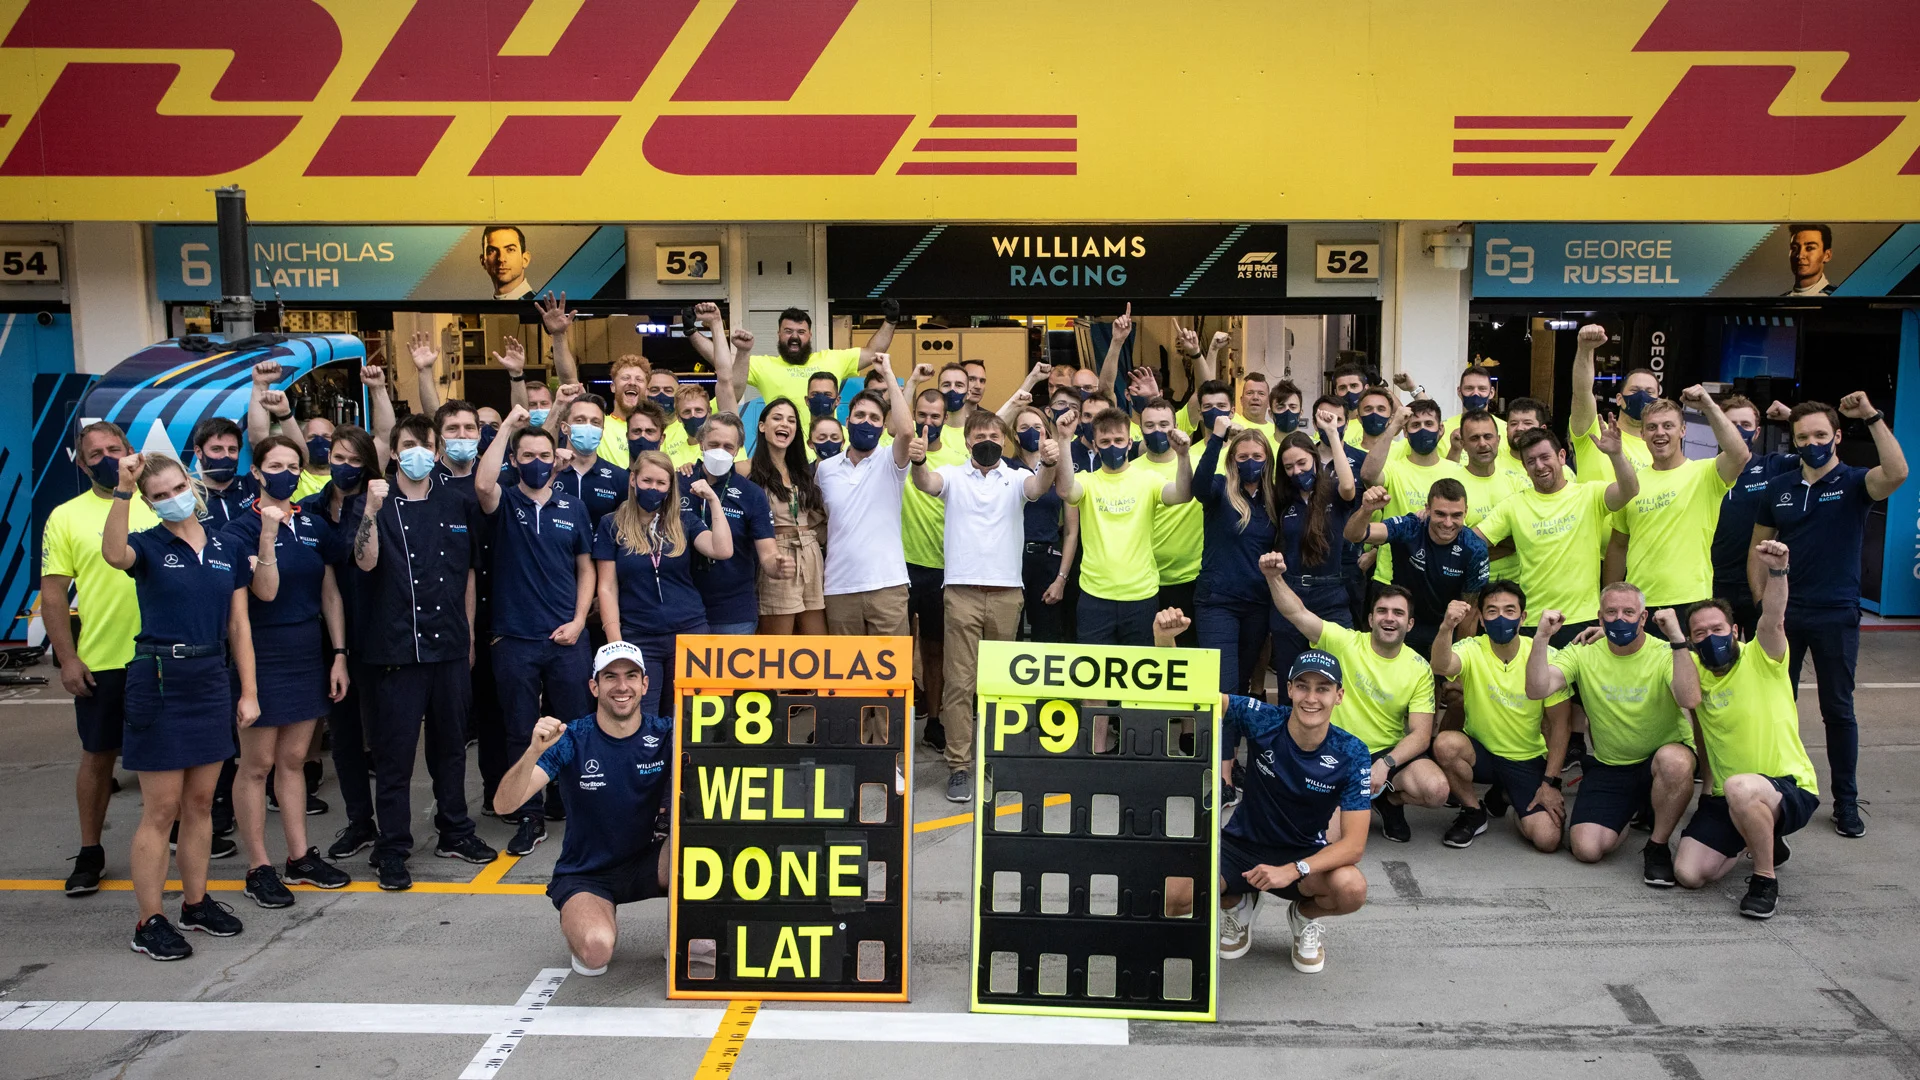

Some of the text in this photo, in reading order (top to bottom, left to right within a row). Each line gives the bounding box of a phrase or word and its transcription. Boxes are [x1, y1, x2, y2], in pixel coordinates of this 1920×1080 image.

[0, 0, 916, 177] DHL
[254, 242, 395, 262] NICHOLAS
[991, 236, 1147, 258] WILLIAMS
[1565, 240, 1672, 259] GEORGE
[3, 251, 47, 275] 54
[180, 243, 212, 286] 6
[665, 251, 709, 276] 53
[1327, 250, 1368, 274] 52
[1485, 238, 1535, 284] 63
[255, 268, 339, 287] LATIFI
[1010, 264, 1127, 287] RACING
[1563, 265, 1680, 284] RUSSELL
[1650, 331, 1665, 396] GEOR
[1095, 497, 1136, 507] WILLIAMS
[1635, 491, 1677, 506] WILLIAMS
[1098, 505, 1131, 513] RACING
[552, 518, 574, 527] WILLIAMS
[1532, 515, 1577, 529] WILLIAMS
[1536, 524, 1573, 536] RACING
[601, 643, 638, 654] WILLIAMS
[686, 647, 897, 680] NICHOLAS
[1300, 653, 1335, 665] WILLIAMS
[1301, 659, 1331, 668] RACING
[1009, 653, 1188, 691] GEORGE
[691, 692, 773, 745] P8
[994, 700, 1079, 753] P9
[636, 760, 665, 769] WILLIAMS
[639, 767, 662, 775] RACING
[1305, 777, 1336, 790] WILLIAMS
[1306, 783, 1331, 794] RACING
[698, 766, 845, 821] WELL
[683, 846, 863, 900] DONE
[736, 926, 833, 978] LAT
[527, 1002, 546, 1011] 10
[506, 1029, 525, 1038] 10
[728, 1033, 745, 1042] 10
[740, 1006, 758, 1014] 10
[485, 1058, 504, 1069] 30
